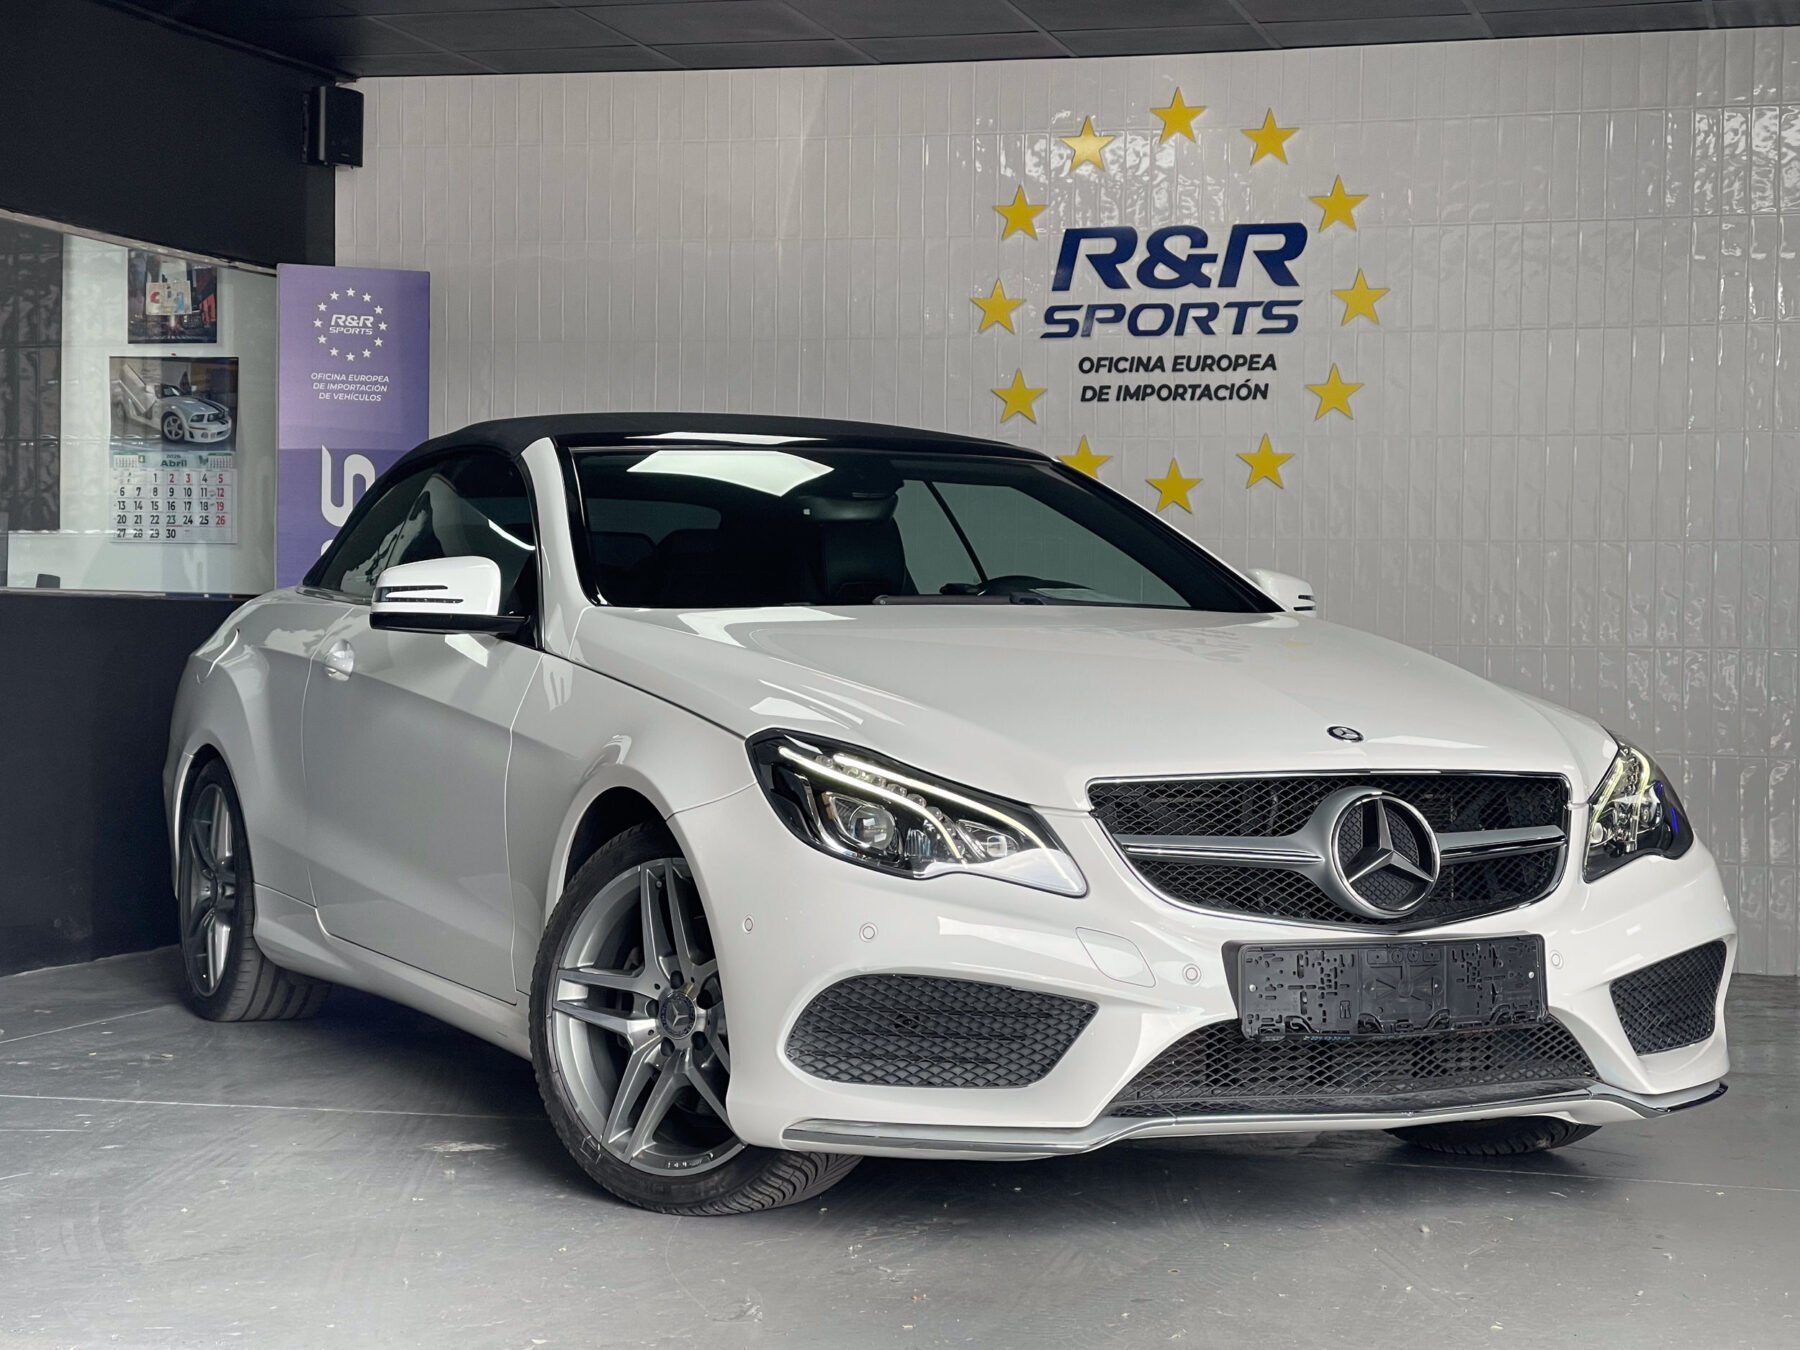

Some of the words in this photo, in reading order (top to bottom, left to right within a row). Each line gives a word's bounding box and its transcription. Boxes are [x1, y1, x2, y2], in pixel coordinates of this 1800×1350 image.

[1052, 223, 1308, 291] R&R
[330, 314, 374, 327] R&R
[1040, 300, 1303, 338] SPORTS
[329, 326, 373, 335] SPORTS
[1078, 356, 1166, 374] OFICINA
[1172, 354, 1277, 372] EUROPEA
[311, 372, 346, 381] OFICINA
[348, 374, 389, 382] EUROPEA
[327, 382, 388, 392] IMPORTACIÓN
[1080, 385, 1111, 402] DE
[1116, 379, 1270, 402] IMPORTACIÓN
[333, 392, 381, 401] VEHÍCULOS
[154, 473, 157, 482] 1
[169, 473, 174, 483] 2
[186, 473, 190, 483] 3
[202, 473, 207, 483] 4
[218, 474, 223, 483] 5
[120, 487, 125, 496] 6
[136, 487, 141, 496] 7
[153, 487, 158, 496] 8
[169, 487, 174, 496] 9
[184, 488, 192, 497] 10
[201, 488, 207, 497] 11
[217, 488, 224, 497] 12
[118, 501, 126, 510] 13
[134, 501, 143, 510] 14
[151, 501, 159, 510] 15
[168, 501, 175, 511] 16
[184, 501, 191, 511] 17
[200, 502, 208, 511] 18
[217, 502, 224, 511] 19
[117, 515, 126, 524] 20
[134, 515, 142, 524] 21
[150, 515, 159, 524] 22
[166, 515, 176, 524] 23
[184, 515, 193, 525] 24
[200, 516, 209, 525] 25
[216, 516, 225, 525] 26
[166, 529, 176, 538] 30
